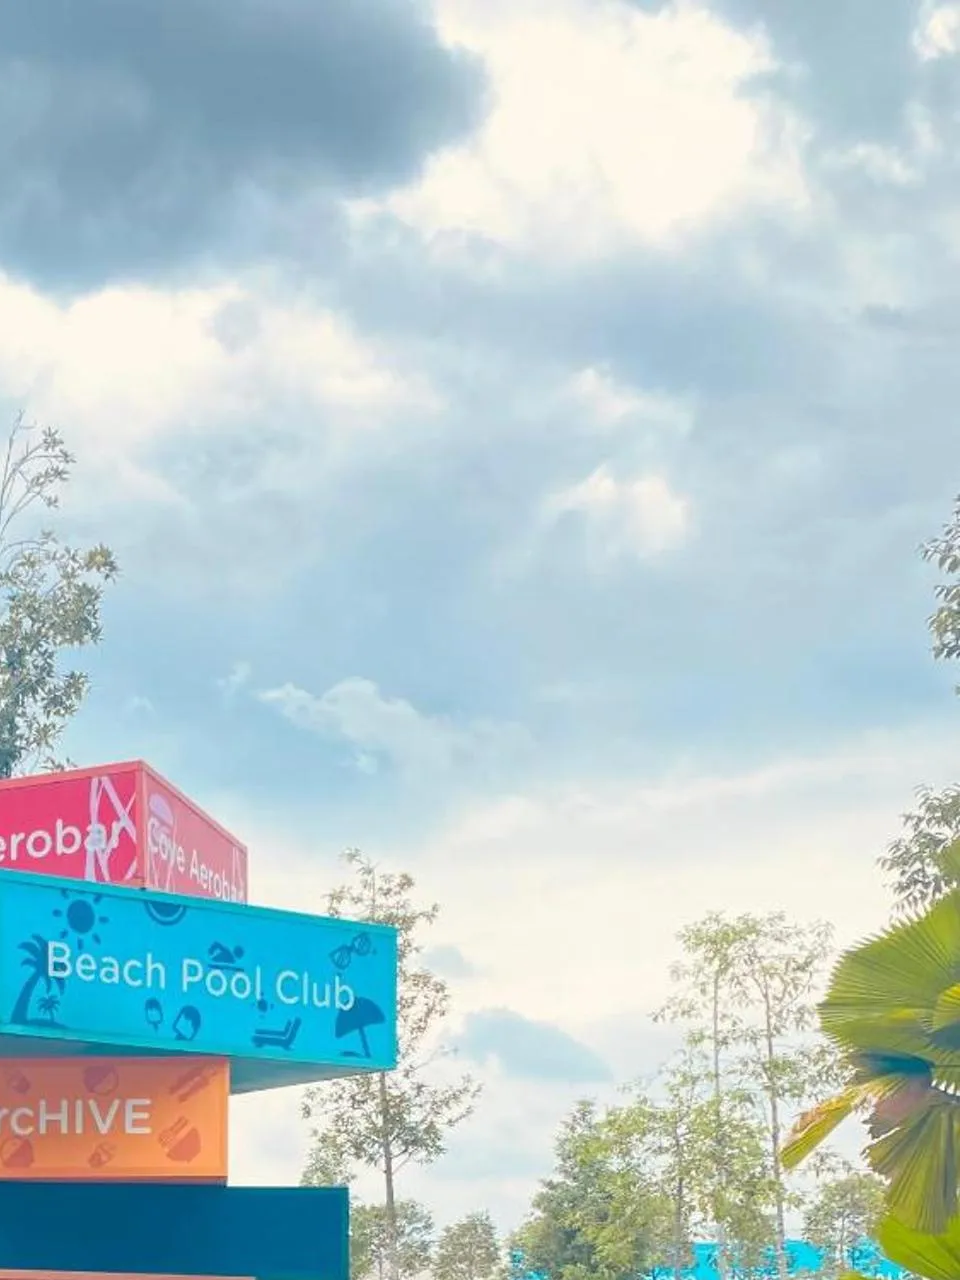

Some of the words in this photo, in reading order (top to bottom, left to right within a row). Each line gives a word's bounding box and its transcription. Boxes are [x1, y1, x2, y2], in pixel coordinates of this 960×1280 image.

[147, 816, 186, 873] Cove
[47, 940, 166, 990] Beach
[181, 964, 262, 1001] Pool
[275, 970, 355, 1011] Club
